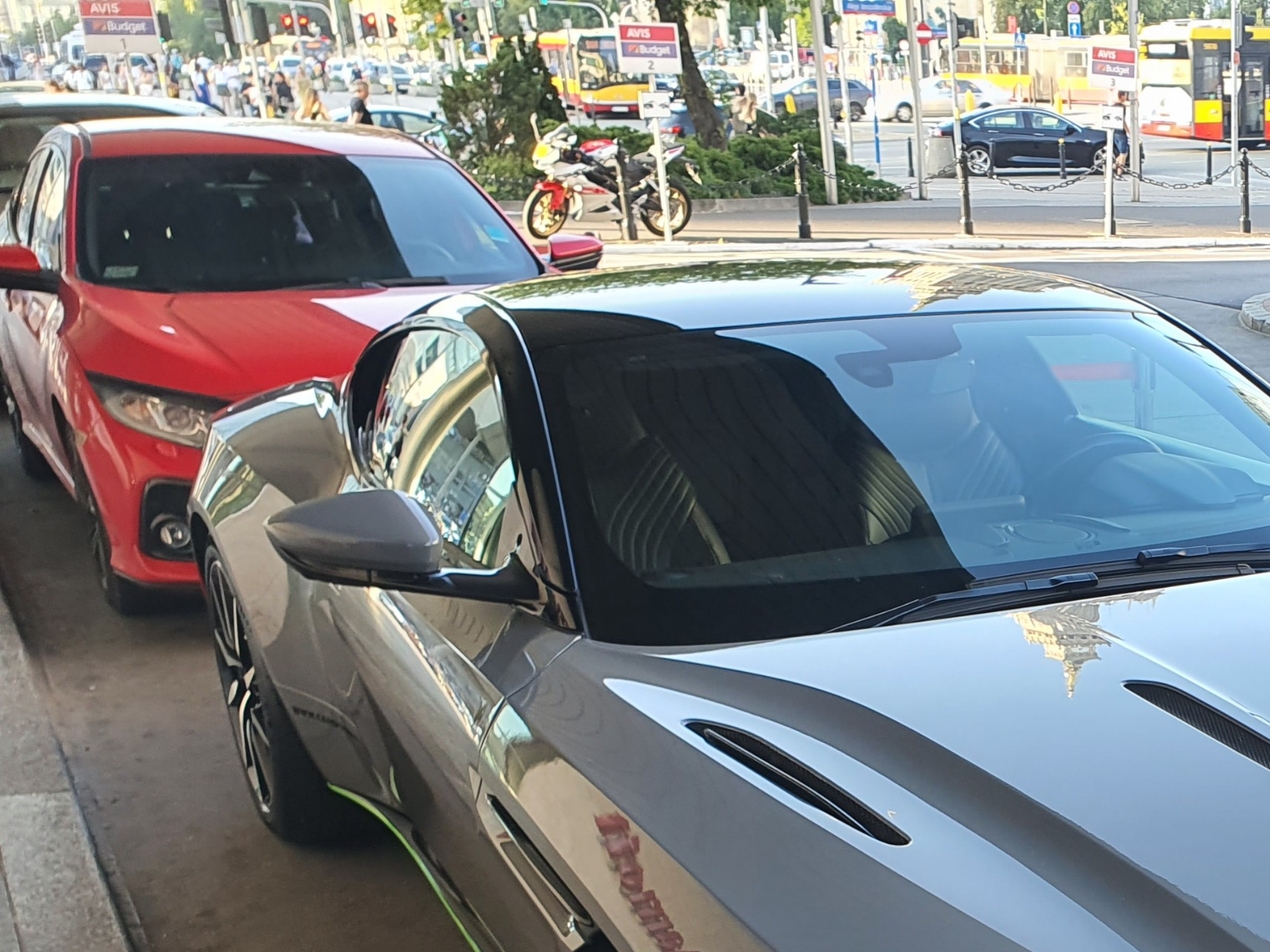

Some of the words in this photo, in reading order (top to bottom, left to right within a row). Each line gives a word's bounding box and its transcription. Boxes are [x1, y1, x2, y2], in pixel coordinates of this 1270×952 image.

[90, 2, 121, 15] AVIS
[106, 20, 147, 34] Budget
[626, 27, 651, 39] AVIS
[638, 44, 671, 57] Budget
[1097, 49, 1117, 60] AVIS
[647, 60, 655, 70] 2
[1105, 64, 1130, 76] Budget
[1110, 78, 1116, 87] 3
